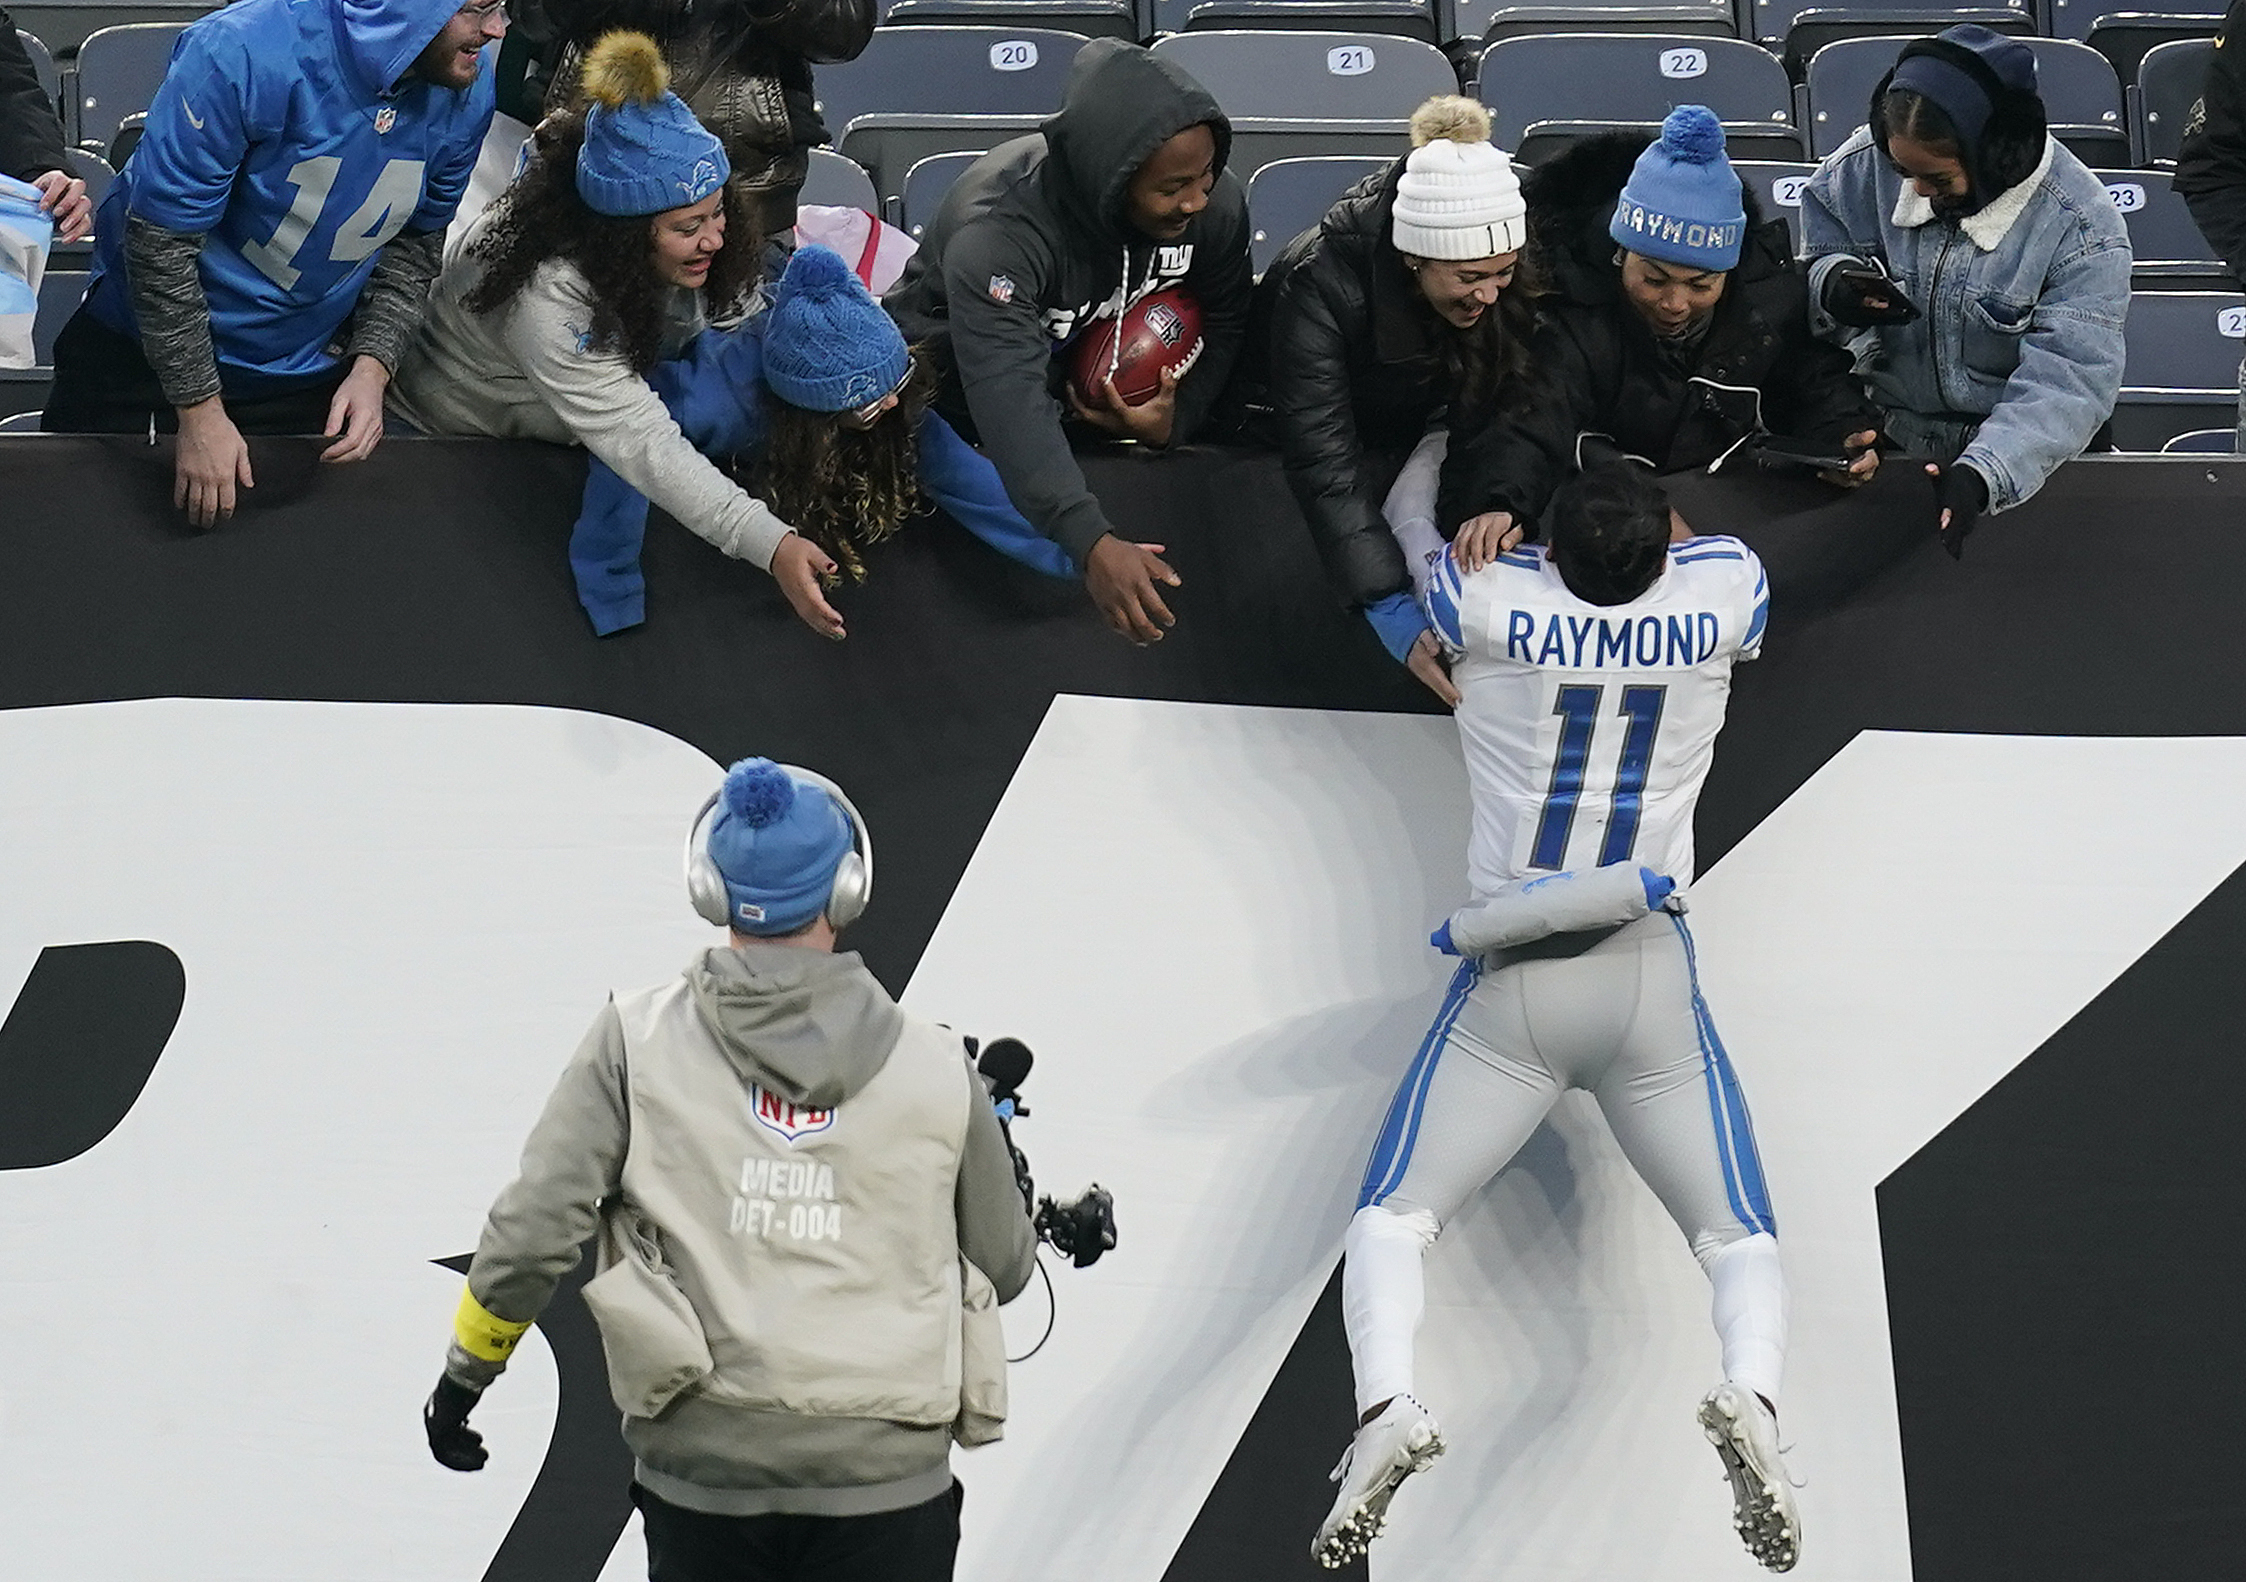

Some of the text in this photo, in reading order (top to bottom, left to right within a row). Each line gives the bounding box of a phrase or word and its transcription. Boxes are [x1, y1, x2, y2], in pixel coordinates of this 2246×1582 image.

[1001, 46, 1027, 64] 20
[1340, 51, 1364, 69] 21
[1671, 54, 1697, 72] 22
[2109, 189, 2135, 206] 23
[240, 155, 426, 292] 14
[1619, 201, 1737, 249] RAYMOND
[2229, 314, 2246, 331] 2
[1508, 610, 1719, 668] RAYMOND
[1528, 683, 1669, 872] 11
[740, 1156, 836, 1201] MEDIA
[730, 1196, 842, 1242] DET-004
